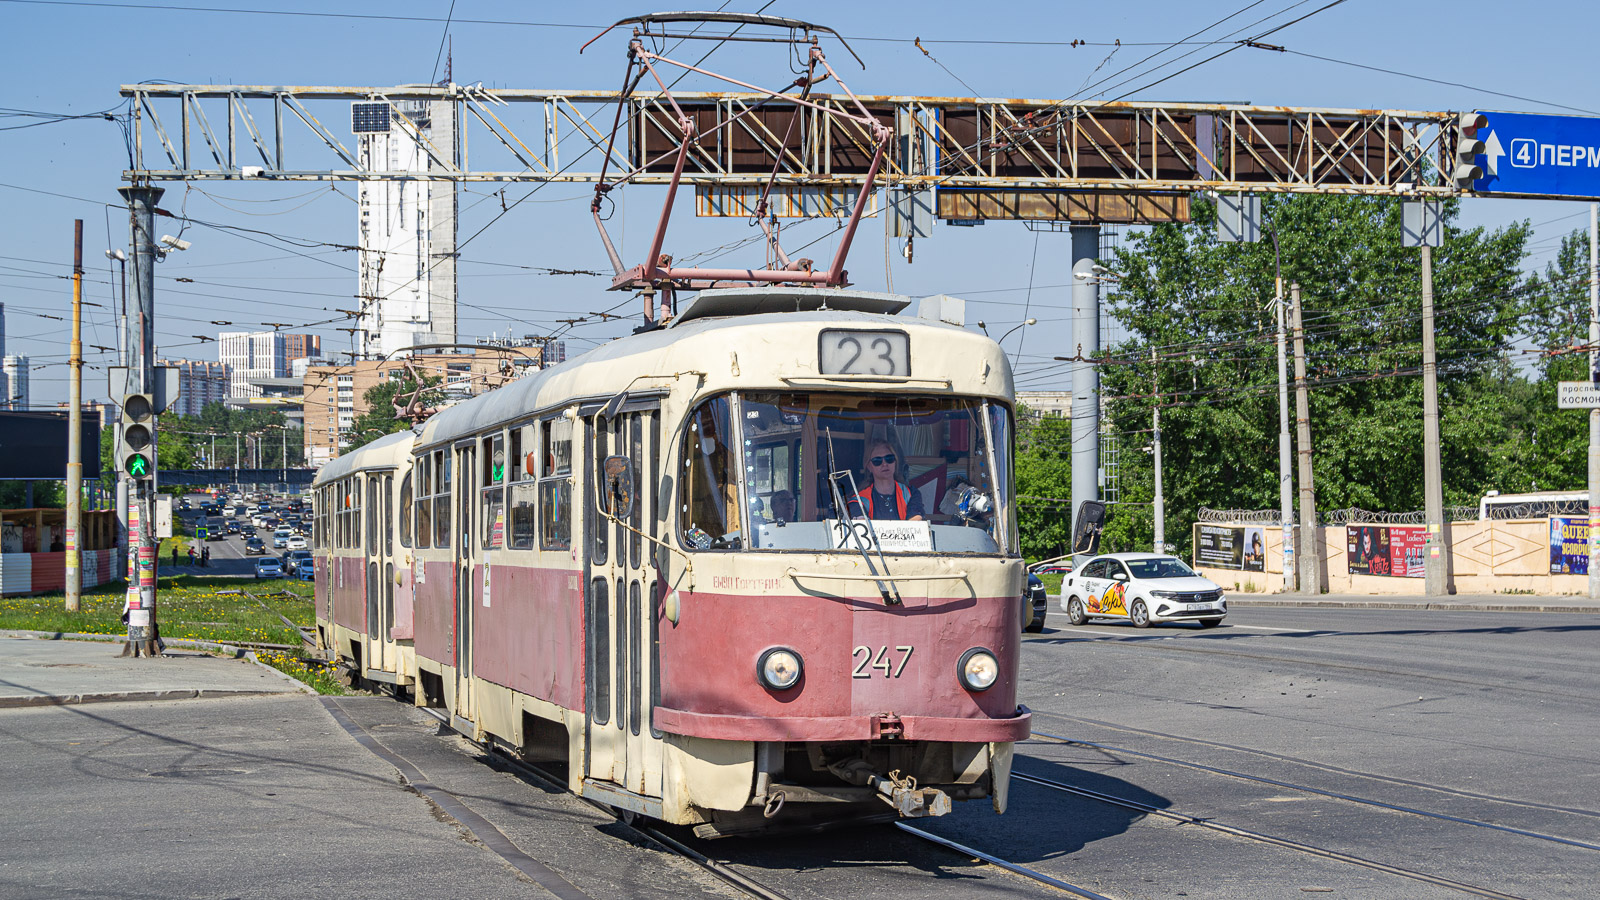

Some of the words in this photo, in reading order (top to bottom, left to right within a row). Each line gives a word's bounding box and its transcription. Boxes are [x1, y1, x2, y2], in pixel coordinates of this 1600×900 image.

[1517, 143, 1531, 164] 4
[1540, 144, 1600, 168] ПЕРМ
[837, 336, 896, 376] 23
[833, 522, 872, 550] 23
[851, 645, 915, 679] 247
